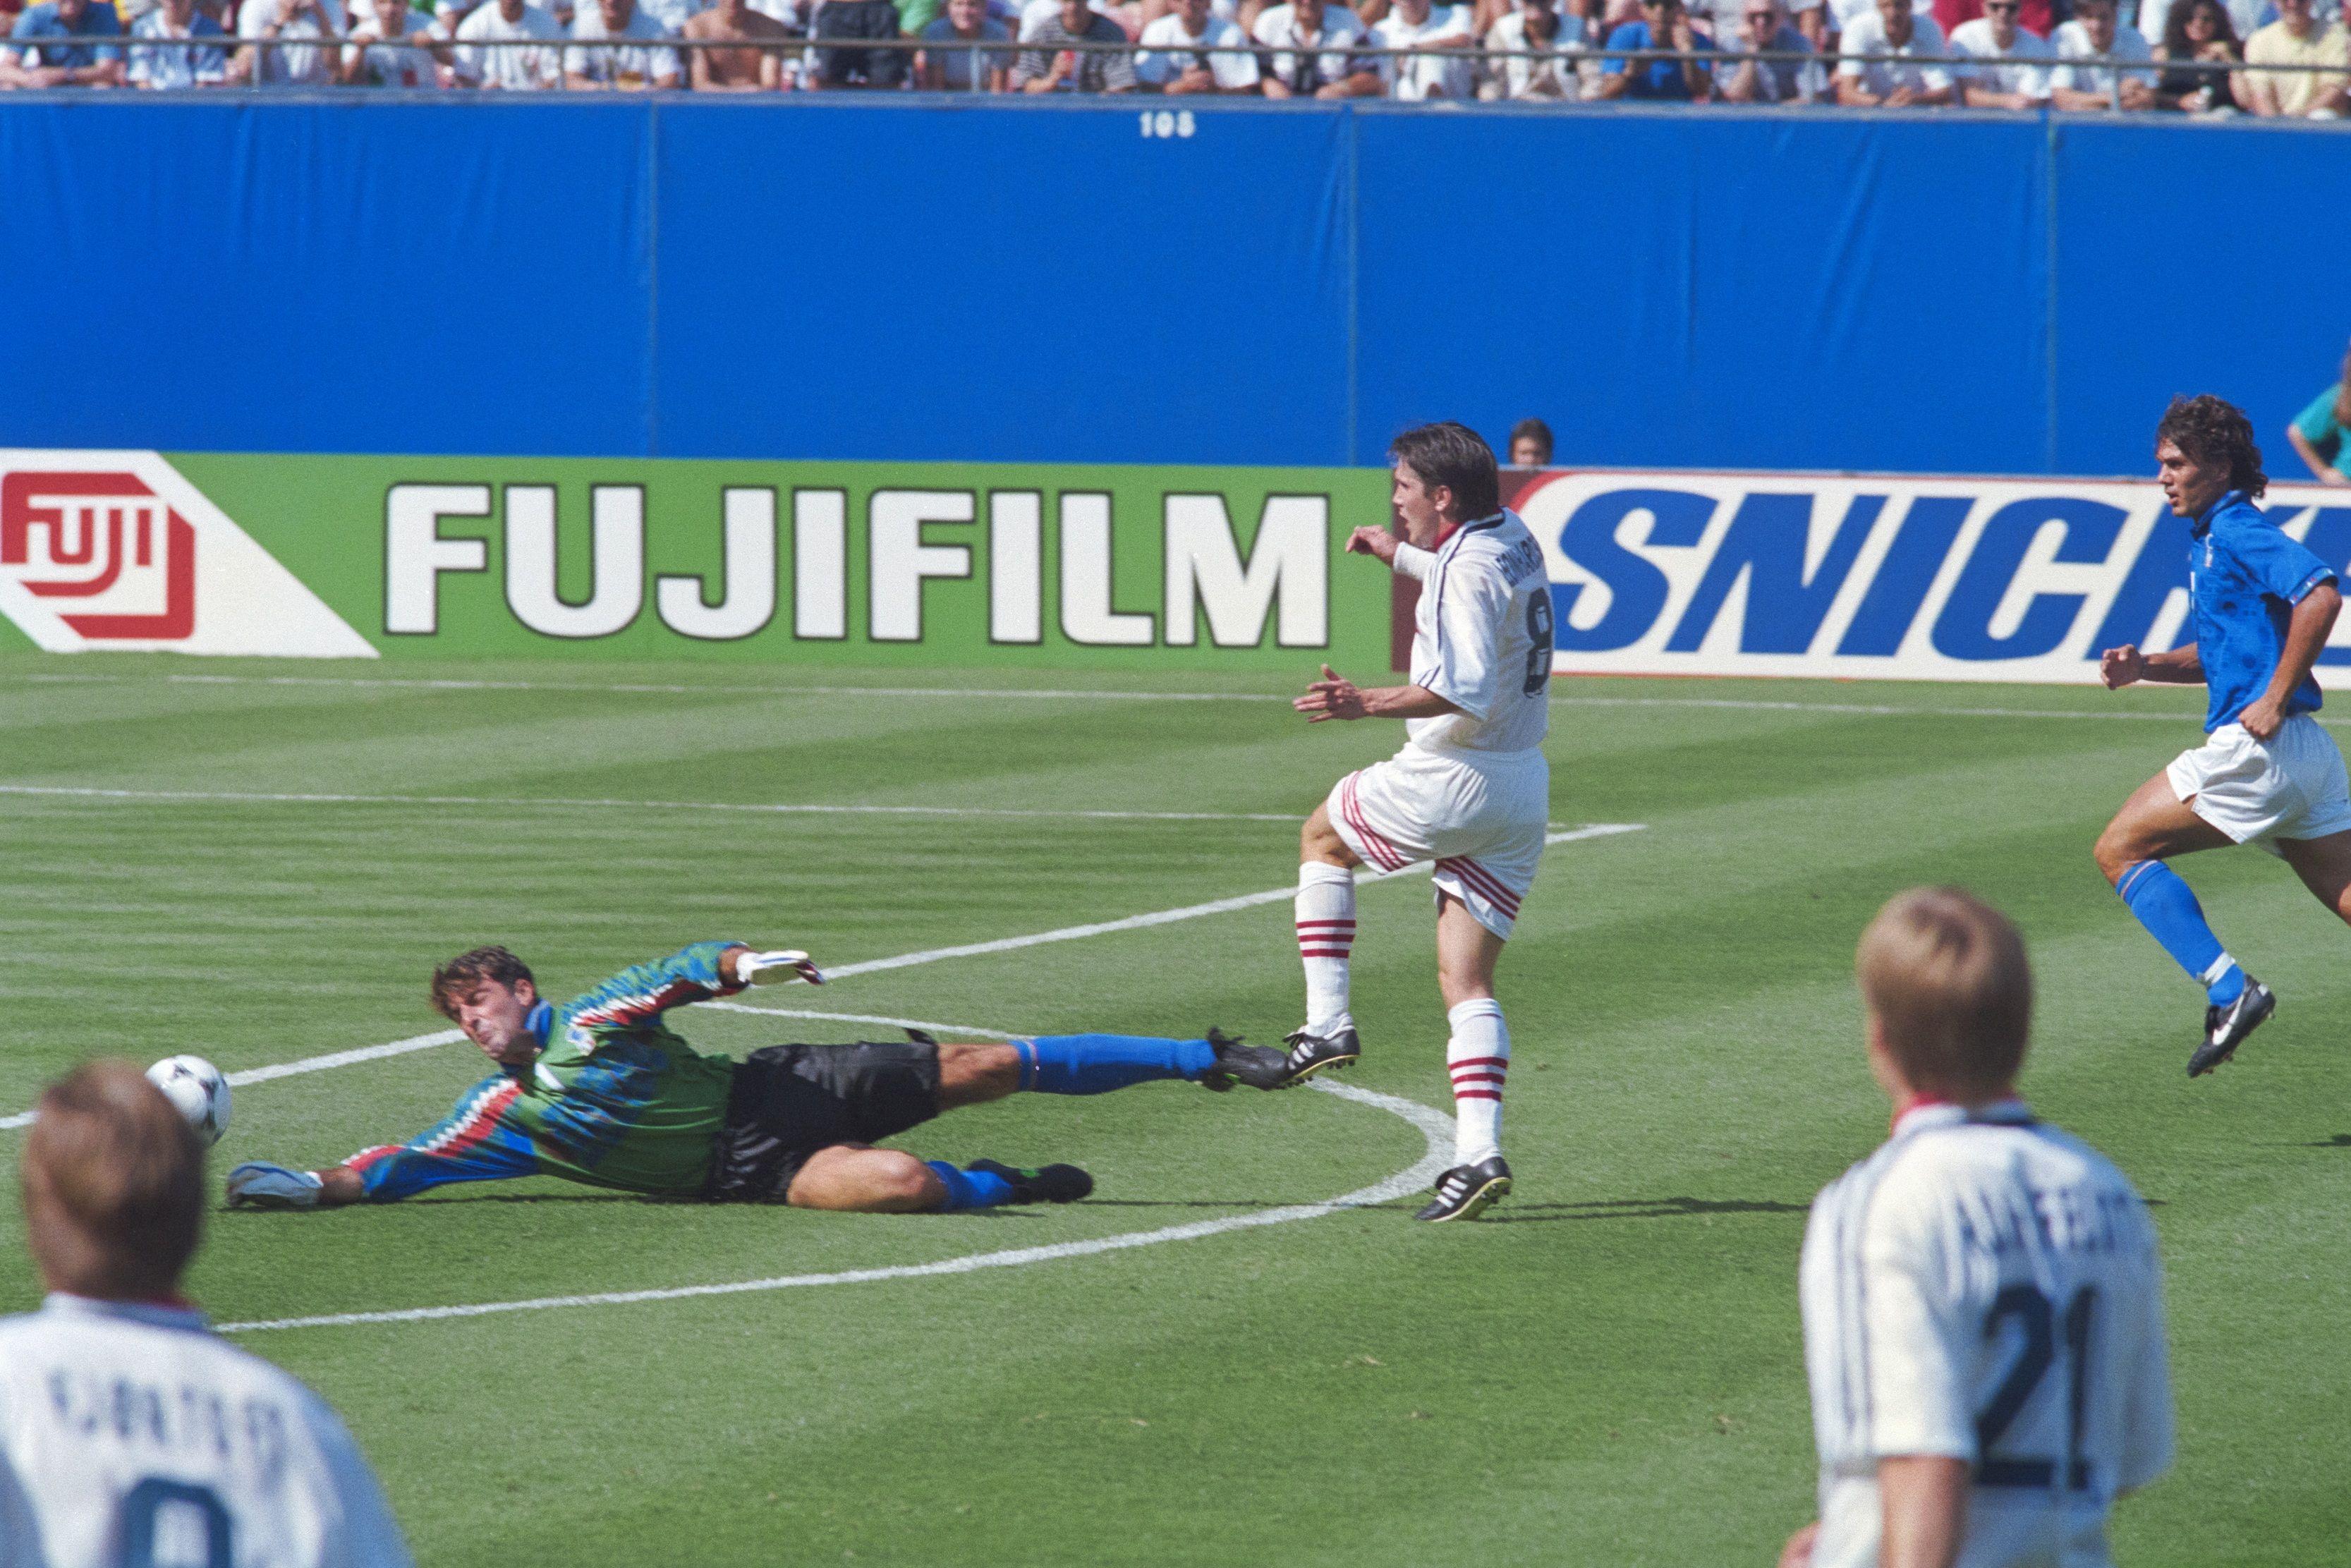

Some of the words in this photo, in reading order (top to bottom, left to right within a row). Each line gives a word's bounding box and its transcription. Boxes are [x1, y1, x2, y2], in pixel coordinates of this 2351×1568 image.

[2, 471, 166, 600] FUJI
[383, 480, 1330, 648] FUJIFILM
[1523, 586, 1553, 698] 8
[1976, 1282, 2098, 1492] 21
